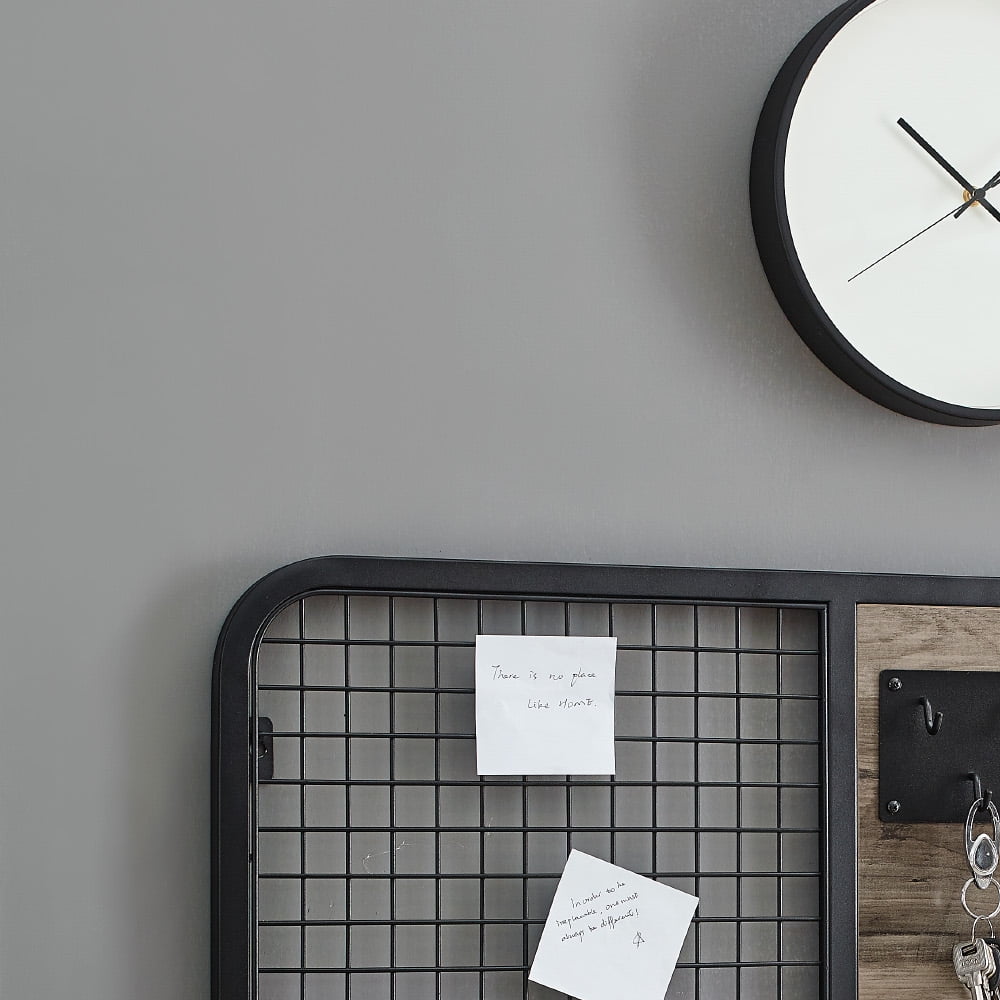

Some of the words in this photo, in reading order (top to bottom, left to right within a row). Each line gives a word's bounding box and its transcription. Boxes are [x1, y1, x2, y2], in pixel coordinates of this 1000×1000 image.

[491, 665, 519, 680] There
[529, 671, 537, 680] is
[570, 667, 596, 687] place
